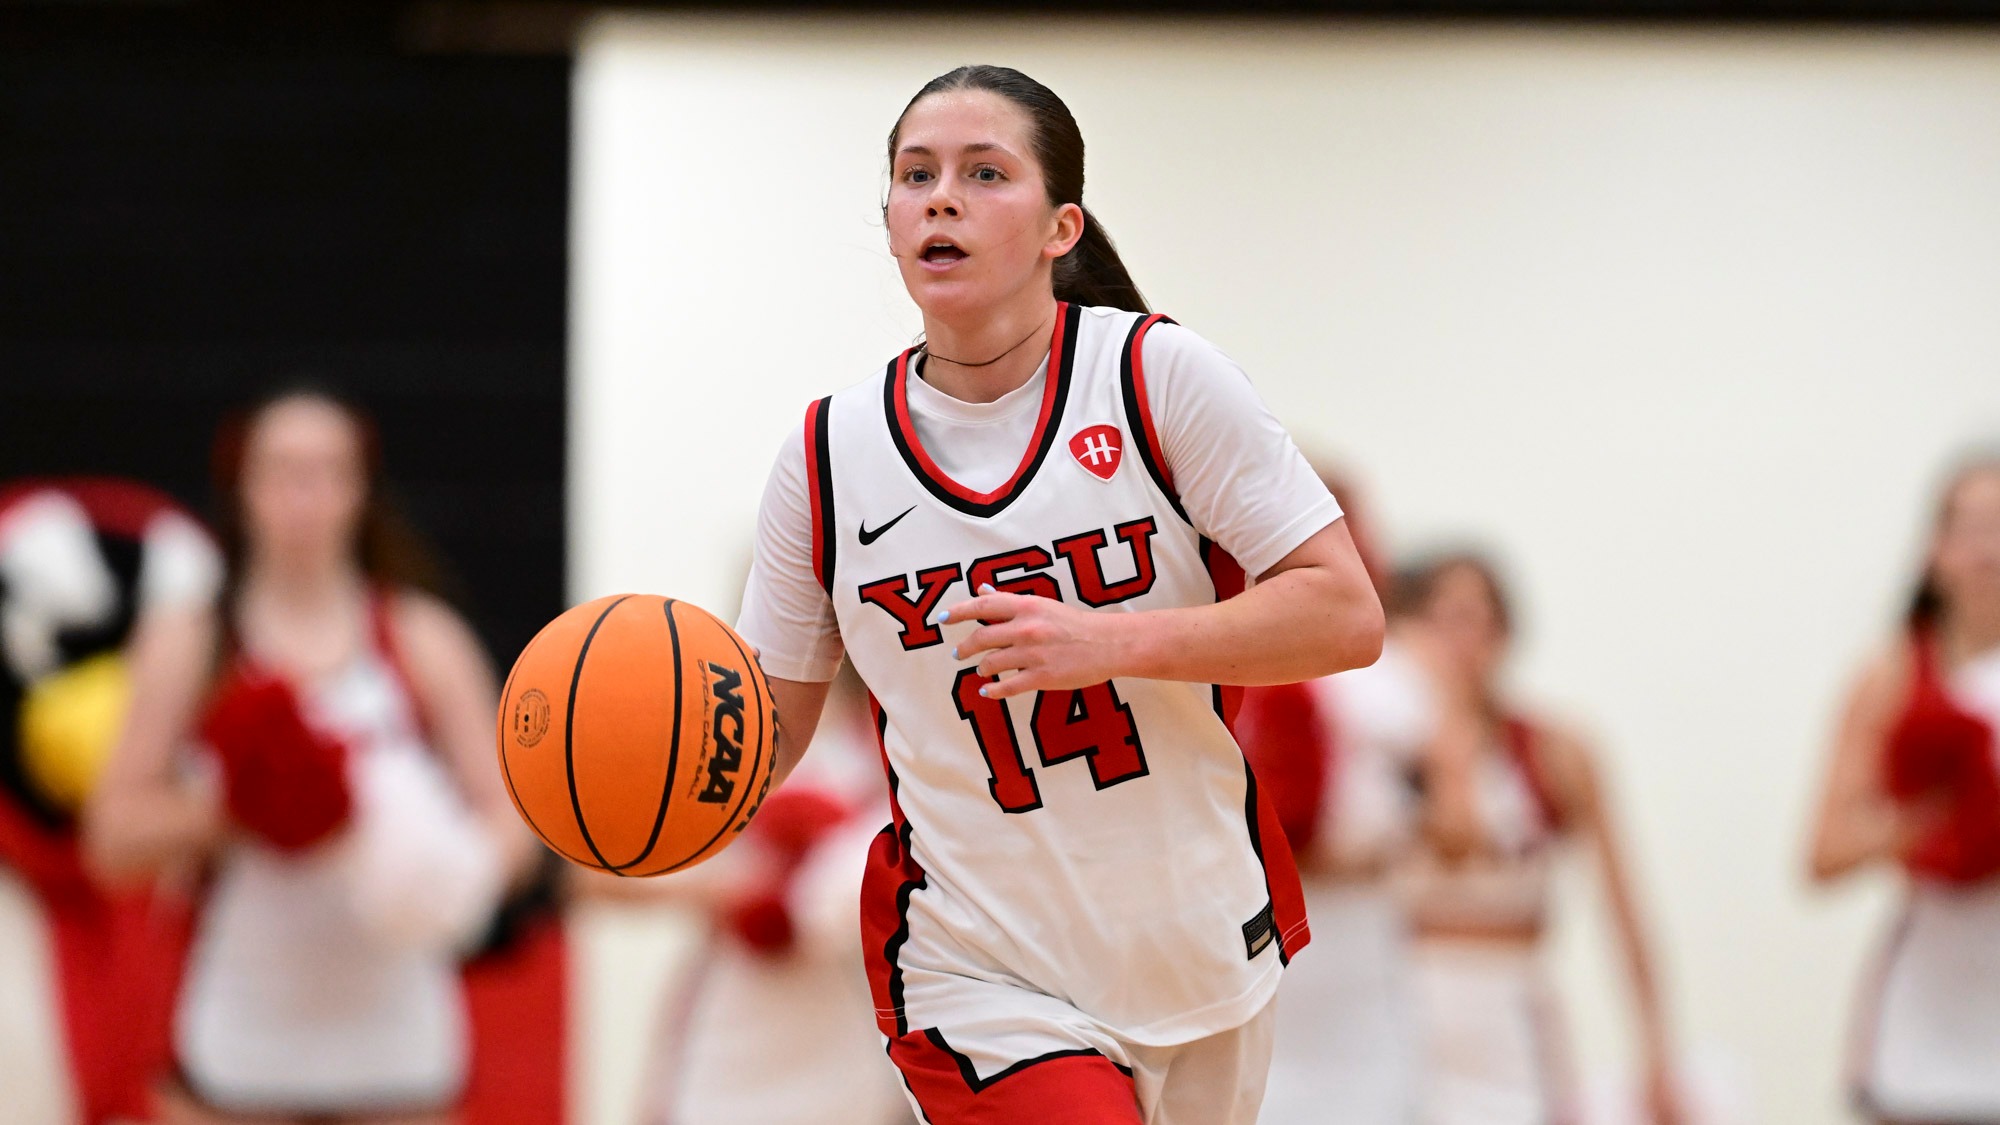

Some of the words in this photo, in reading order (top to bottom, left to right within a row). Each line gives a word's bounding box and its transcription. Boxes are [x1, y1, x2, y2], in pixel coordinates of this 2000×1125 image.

[858, 515, 1158, 651] YSU
[698, 661, 745, 804] NCAA
[952, 665, 1150, 813] 14
